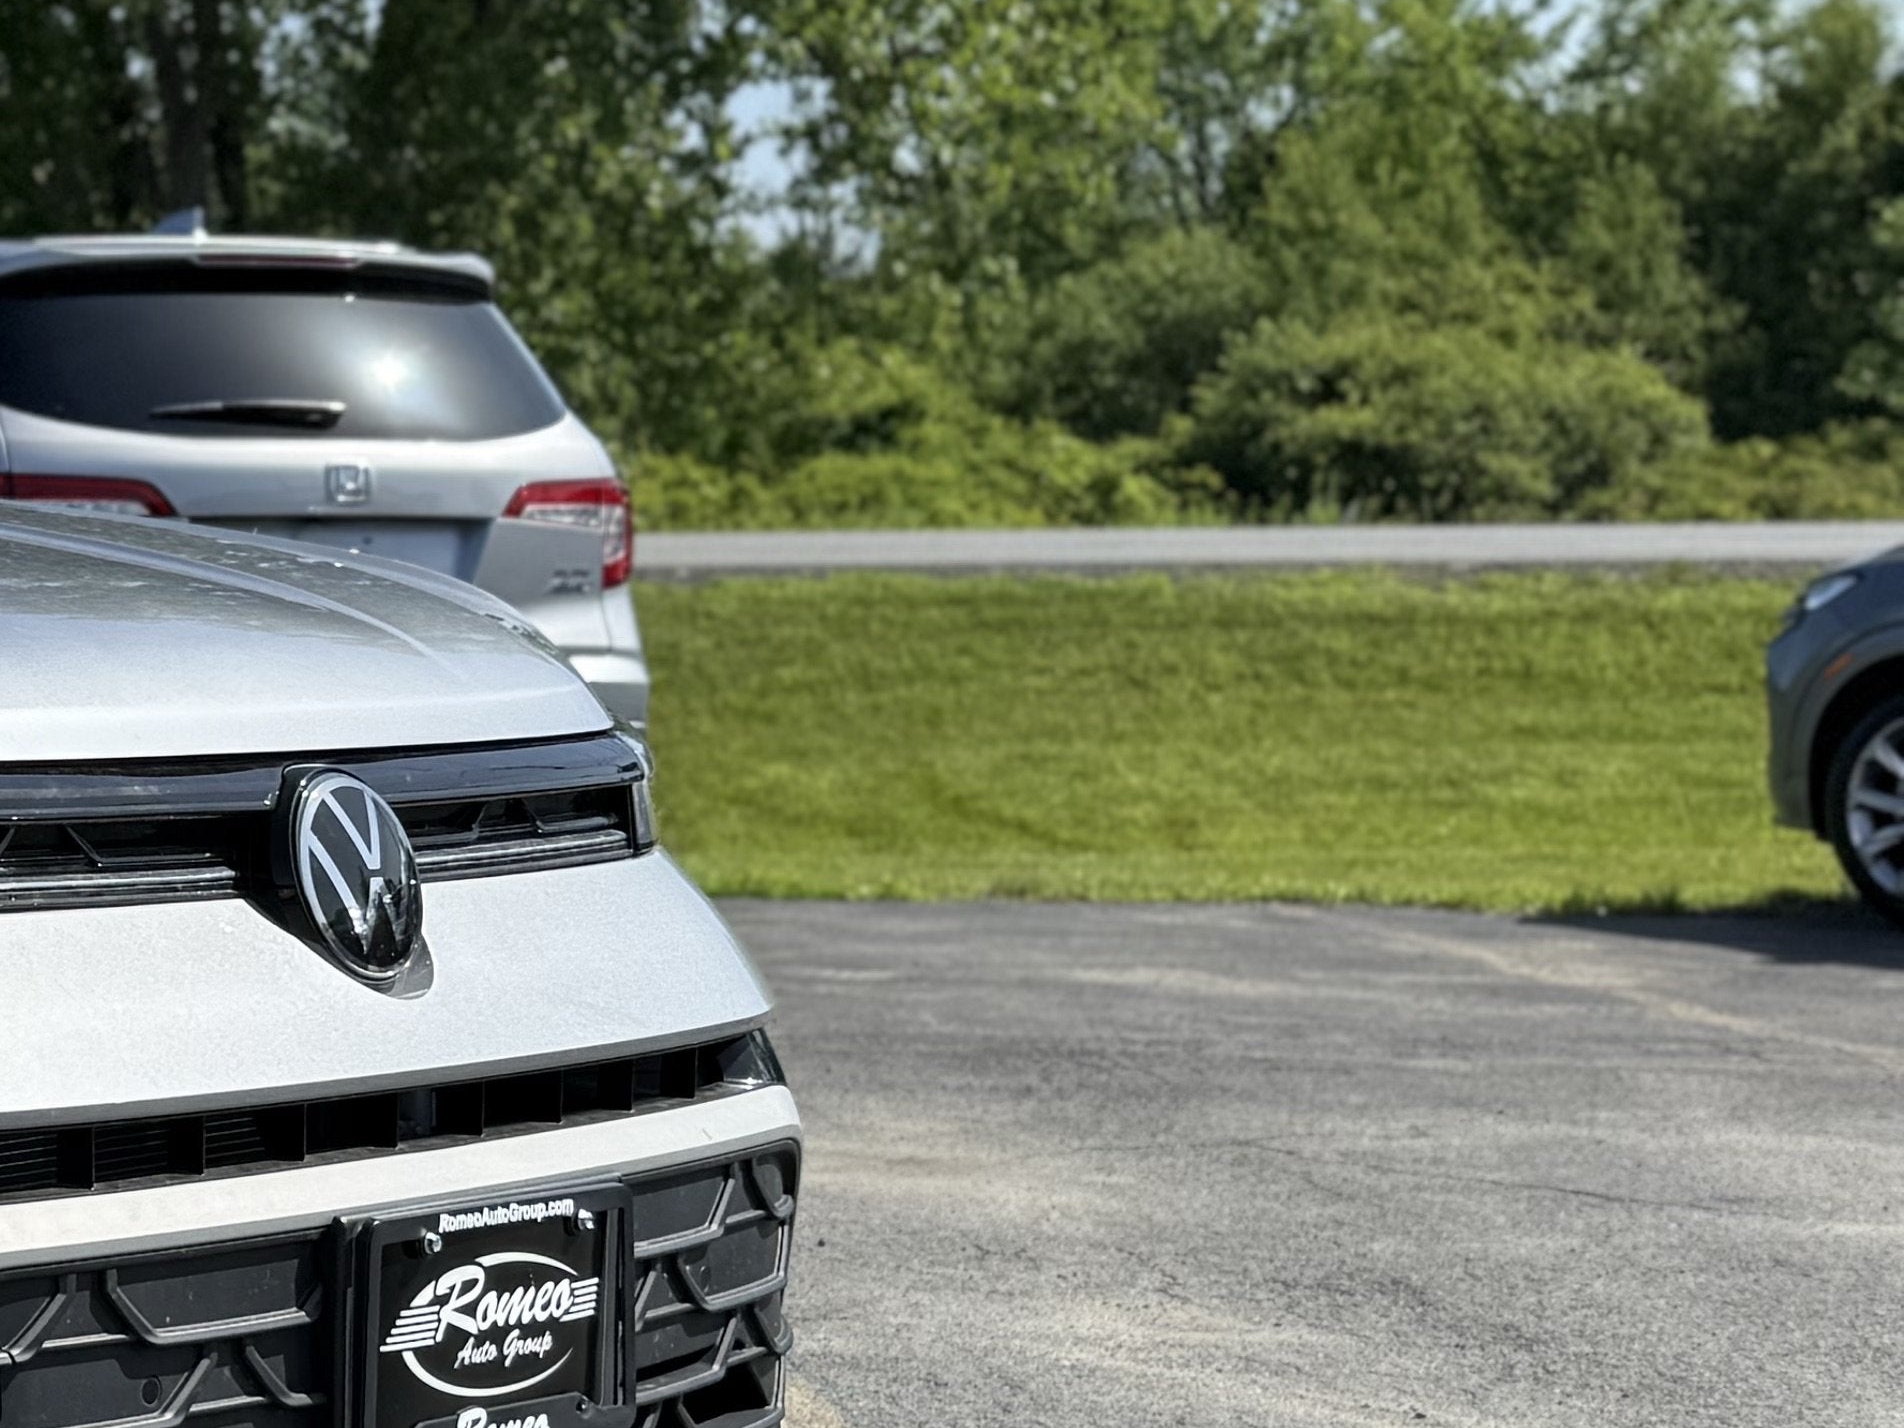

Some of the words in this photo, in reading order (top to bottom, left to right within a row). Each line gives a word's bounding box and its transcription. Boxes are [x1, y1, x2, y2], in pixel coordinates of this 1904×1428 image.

[438, 1198, 574, 1233] RomeoAutoGroup.com
[435, 1264, 574, 1343] Romeo
[453, 1336, 498, 1369] Auto
[502, 1329, 553, 1367] Group
